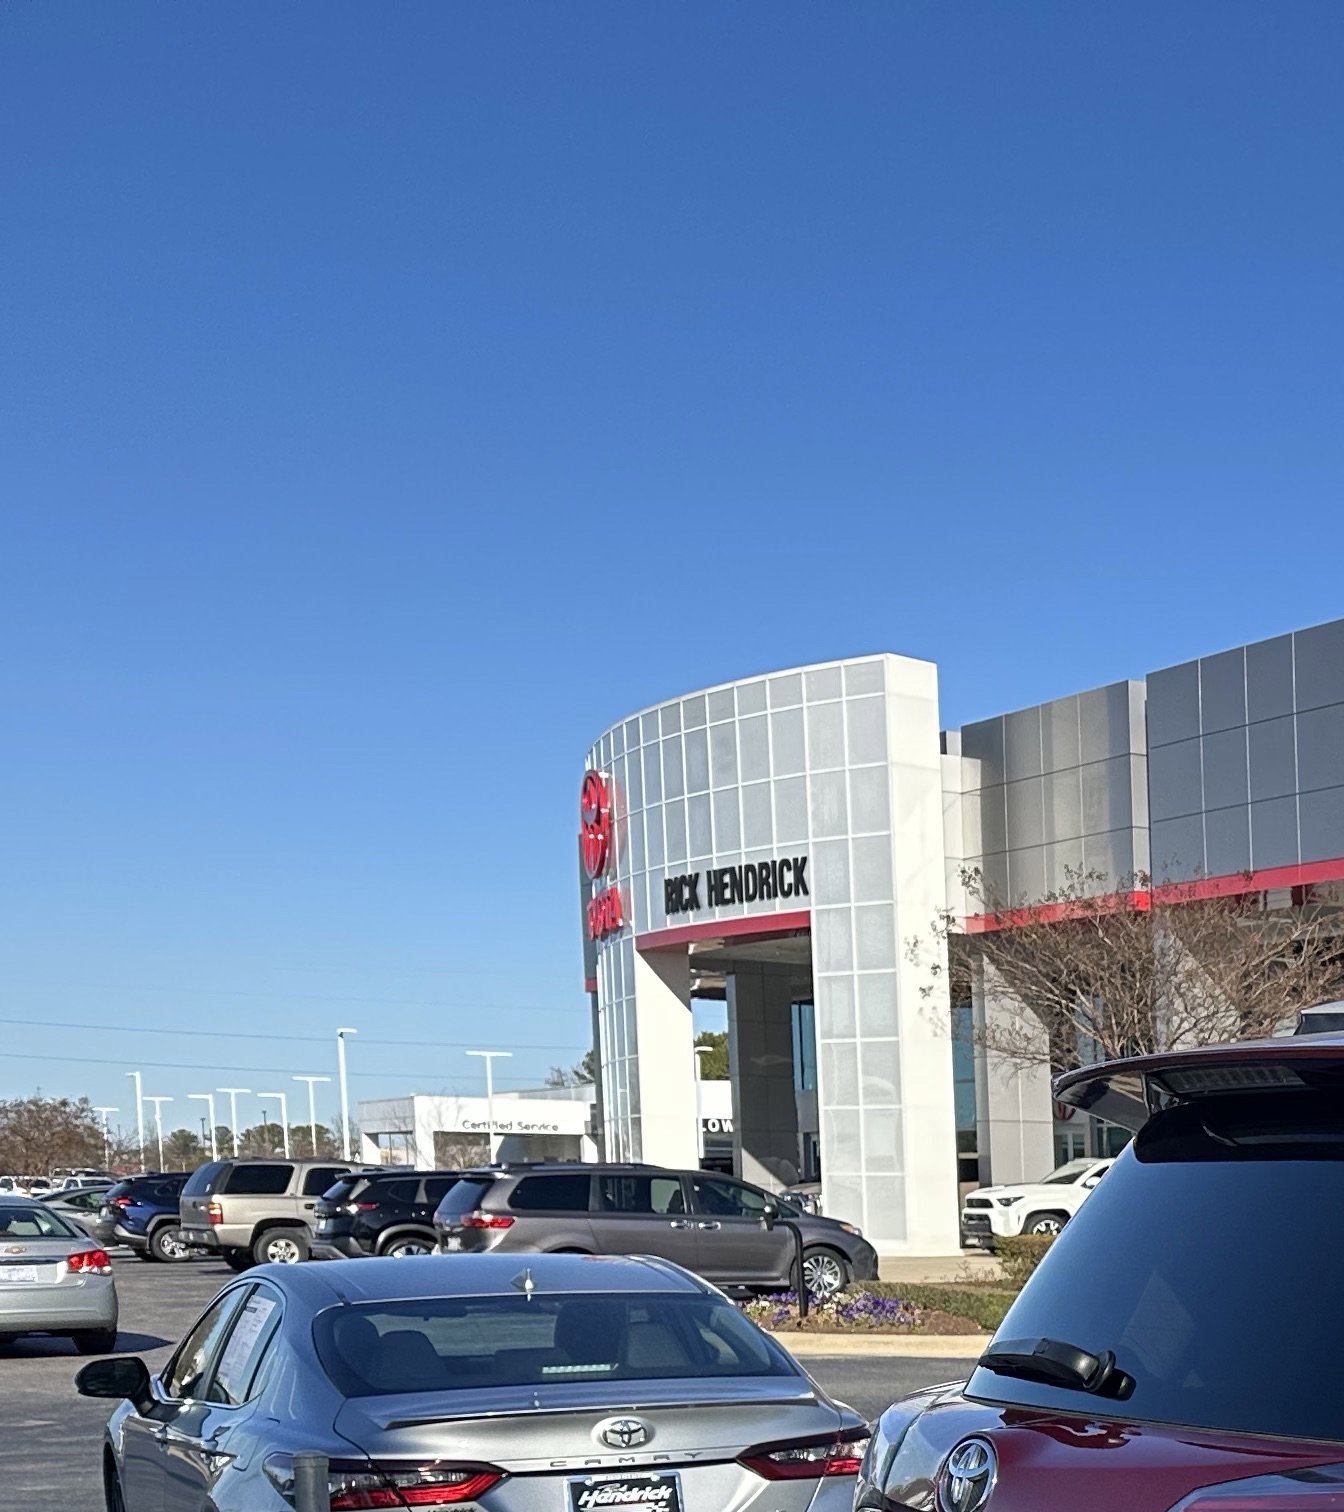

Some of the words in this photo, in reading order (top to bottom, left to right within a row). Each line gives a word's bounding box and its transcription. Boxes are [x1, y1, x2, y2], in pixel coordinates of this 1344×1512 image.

[664, 872, 701, 915] RICK
[706, 856, 810, 909] HENDRICK
[517, 1121, 559, 1132] Service
[550, 1452, 703, 1467] CAMRY
[578, 1485, 673, 1508] Hendrick
